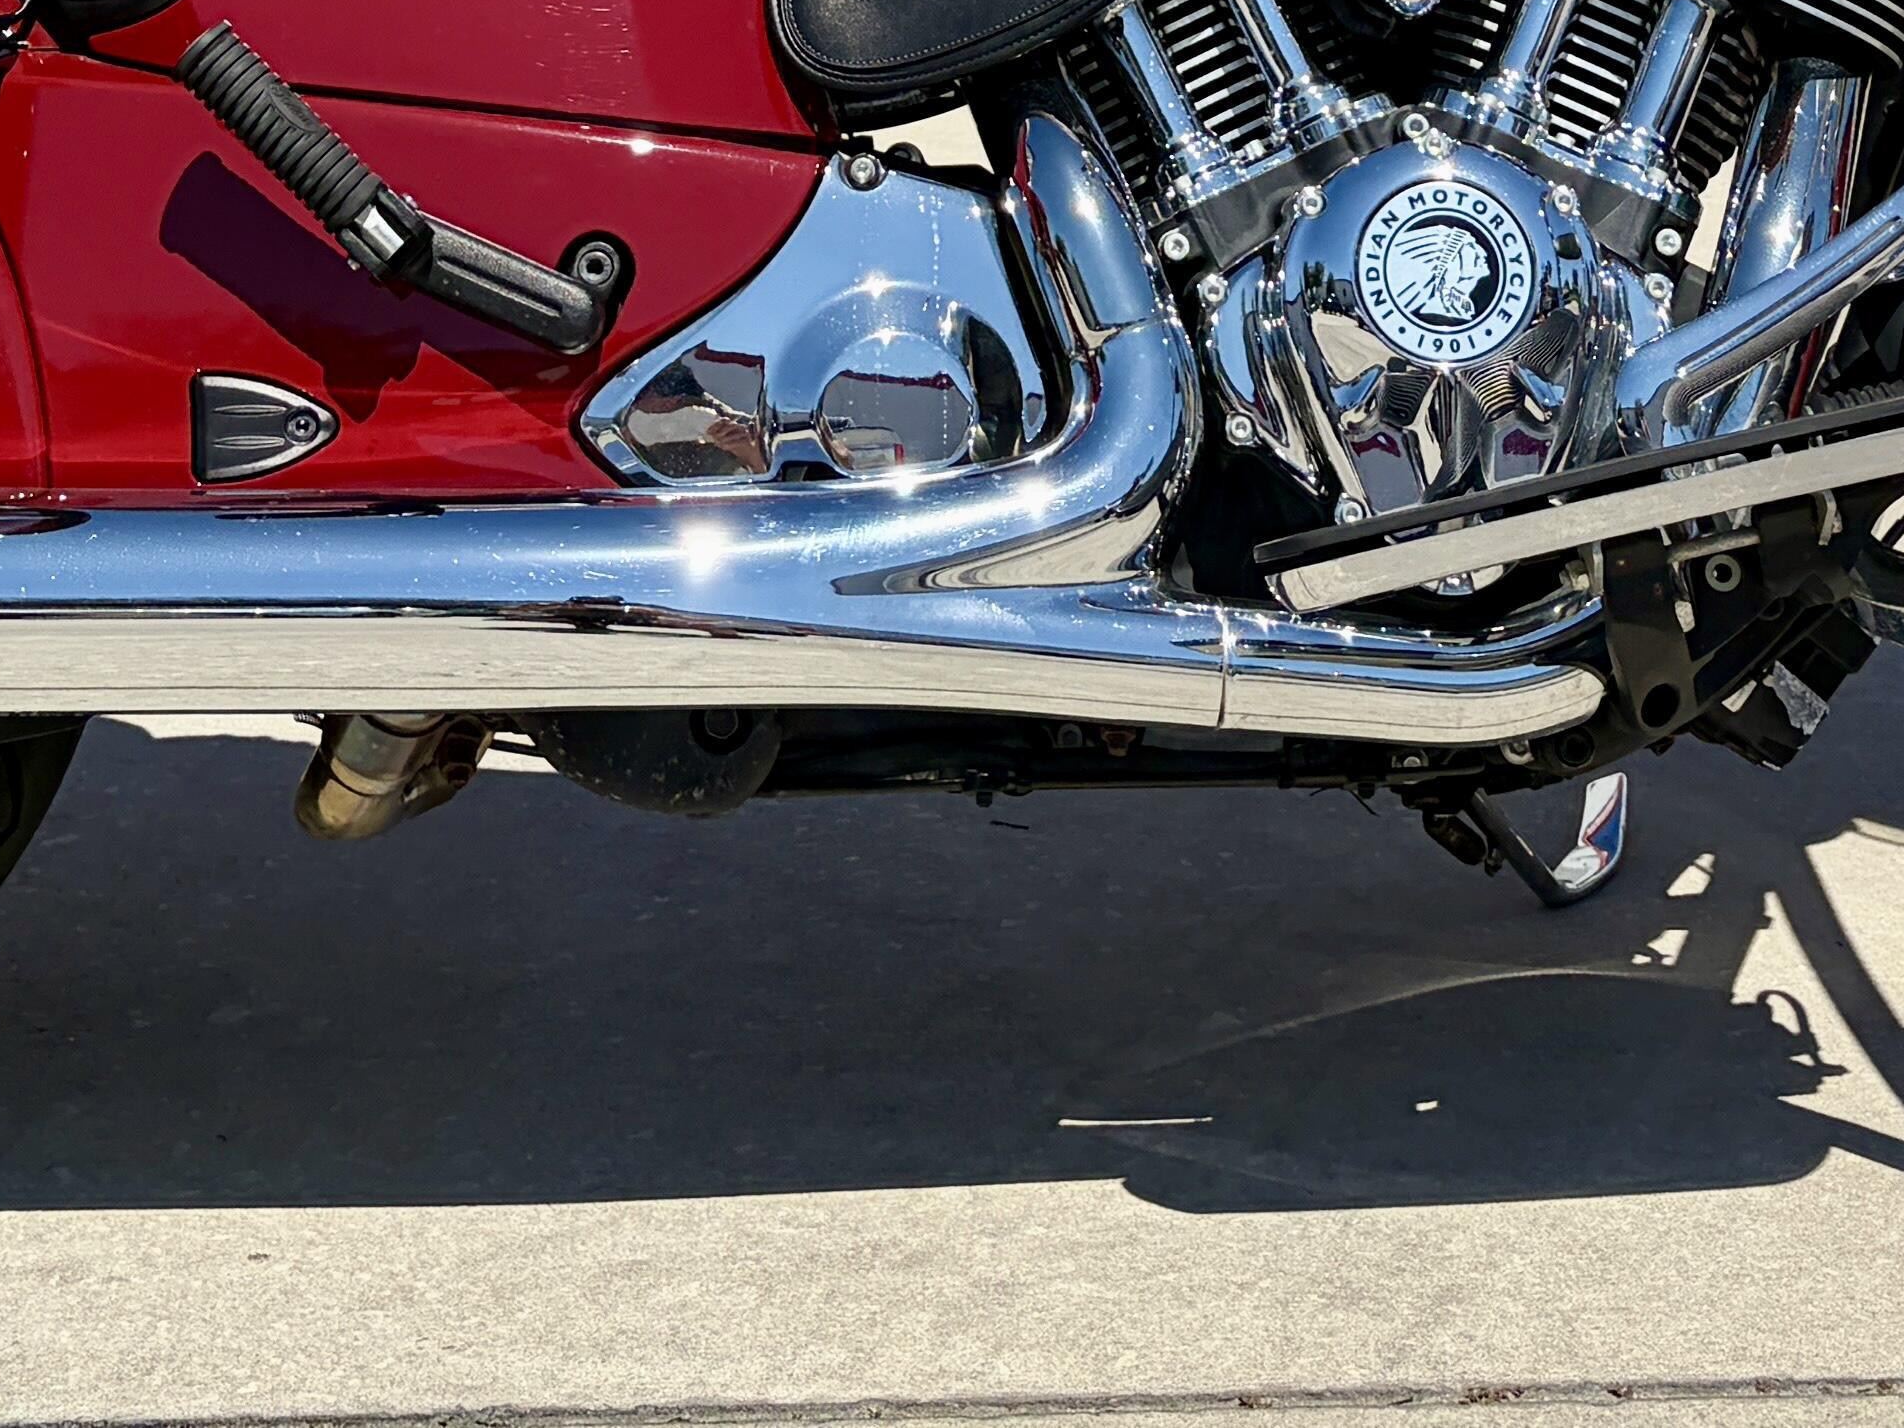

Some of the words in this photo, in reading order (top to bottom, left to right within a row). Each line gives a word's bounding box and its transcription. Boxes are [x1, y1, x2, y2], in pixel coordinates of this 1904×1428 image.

[1366, 210, 1400, 321] INDIAN
[1408, 190, 1524, 324] MOTORCYCLE
[1417, 334, 1476, 353] 1901
